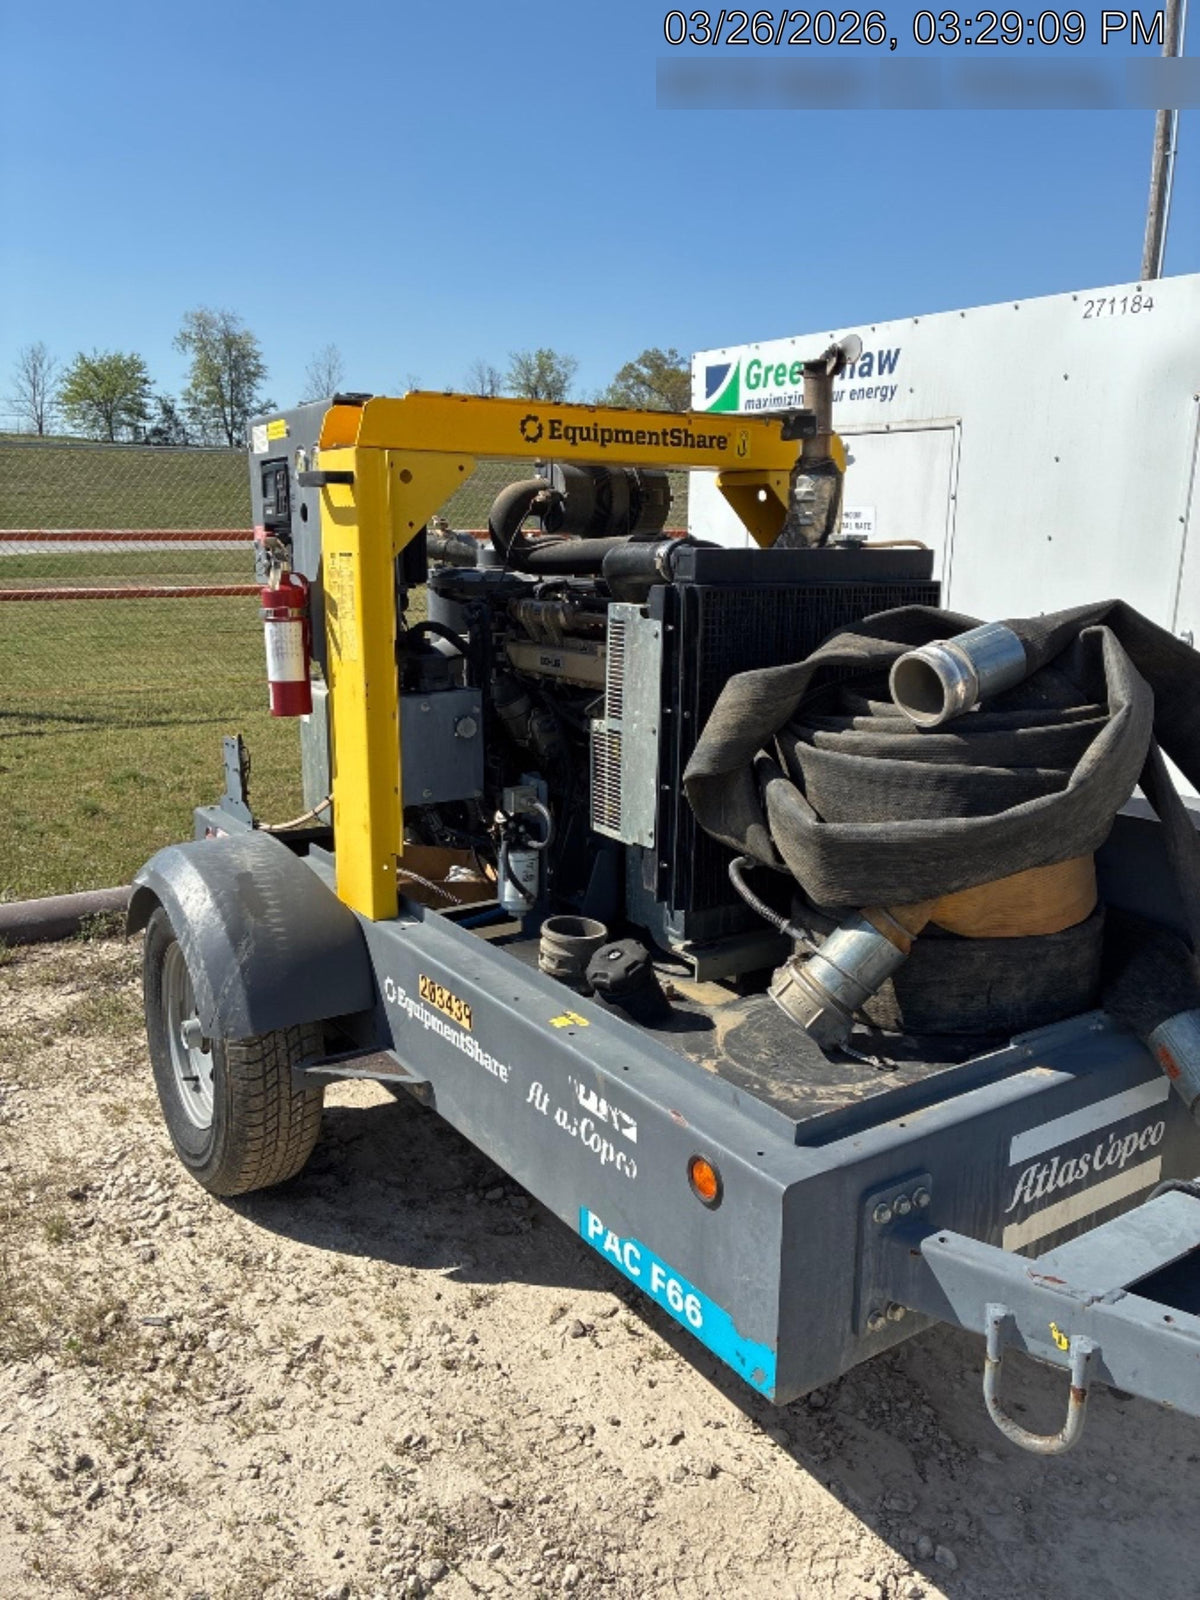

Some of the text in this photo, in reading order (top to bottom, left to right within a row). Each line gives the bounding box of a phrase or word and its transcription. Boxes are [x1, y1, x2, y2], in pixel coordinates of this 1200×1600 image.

[1082, 294, 1154, 319] 271184
[744, 389, 804, 411] maximizin
[849, 383, 898, 403] energy
[548, 419, 728, 450] EquipmentShare
[418, 973, 474, 1032] 203439
[396, 986, 510, 1084] EquipmentShare
[586, 1209, 704, 1330] PAC F66
